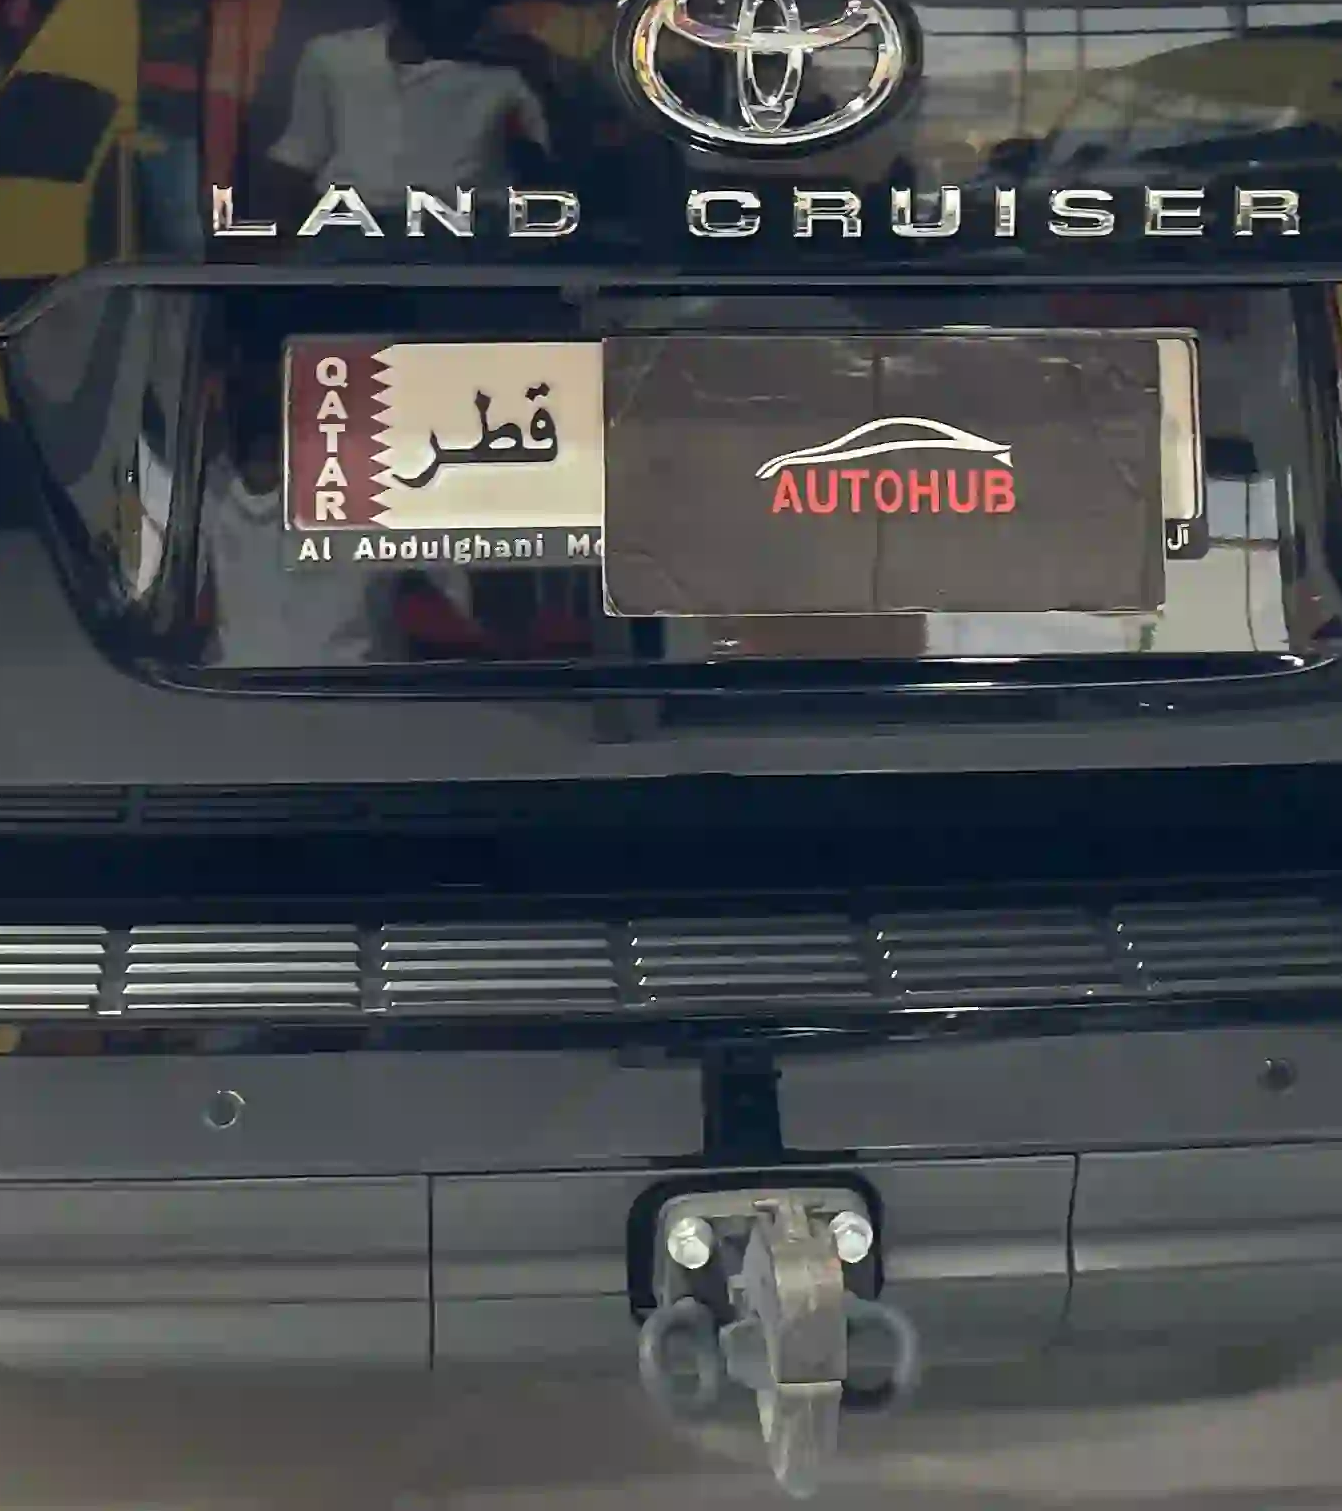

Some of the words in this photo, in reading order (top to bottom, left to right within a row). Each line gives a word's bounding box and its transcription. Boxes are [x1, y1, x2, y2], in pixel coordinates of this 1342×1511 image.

[212, 184, 580, 238] LAND
[687, 187, 1301, 238] CRUISER
[314, 356, 349, 521] QATAR
[392, 382, 558, 489] قطر
[772, 469, 1016, 513] AUTOHUB
[298, 536, 333, 561] Al
[352, 533, 545, 564] Abdulghani
